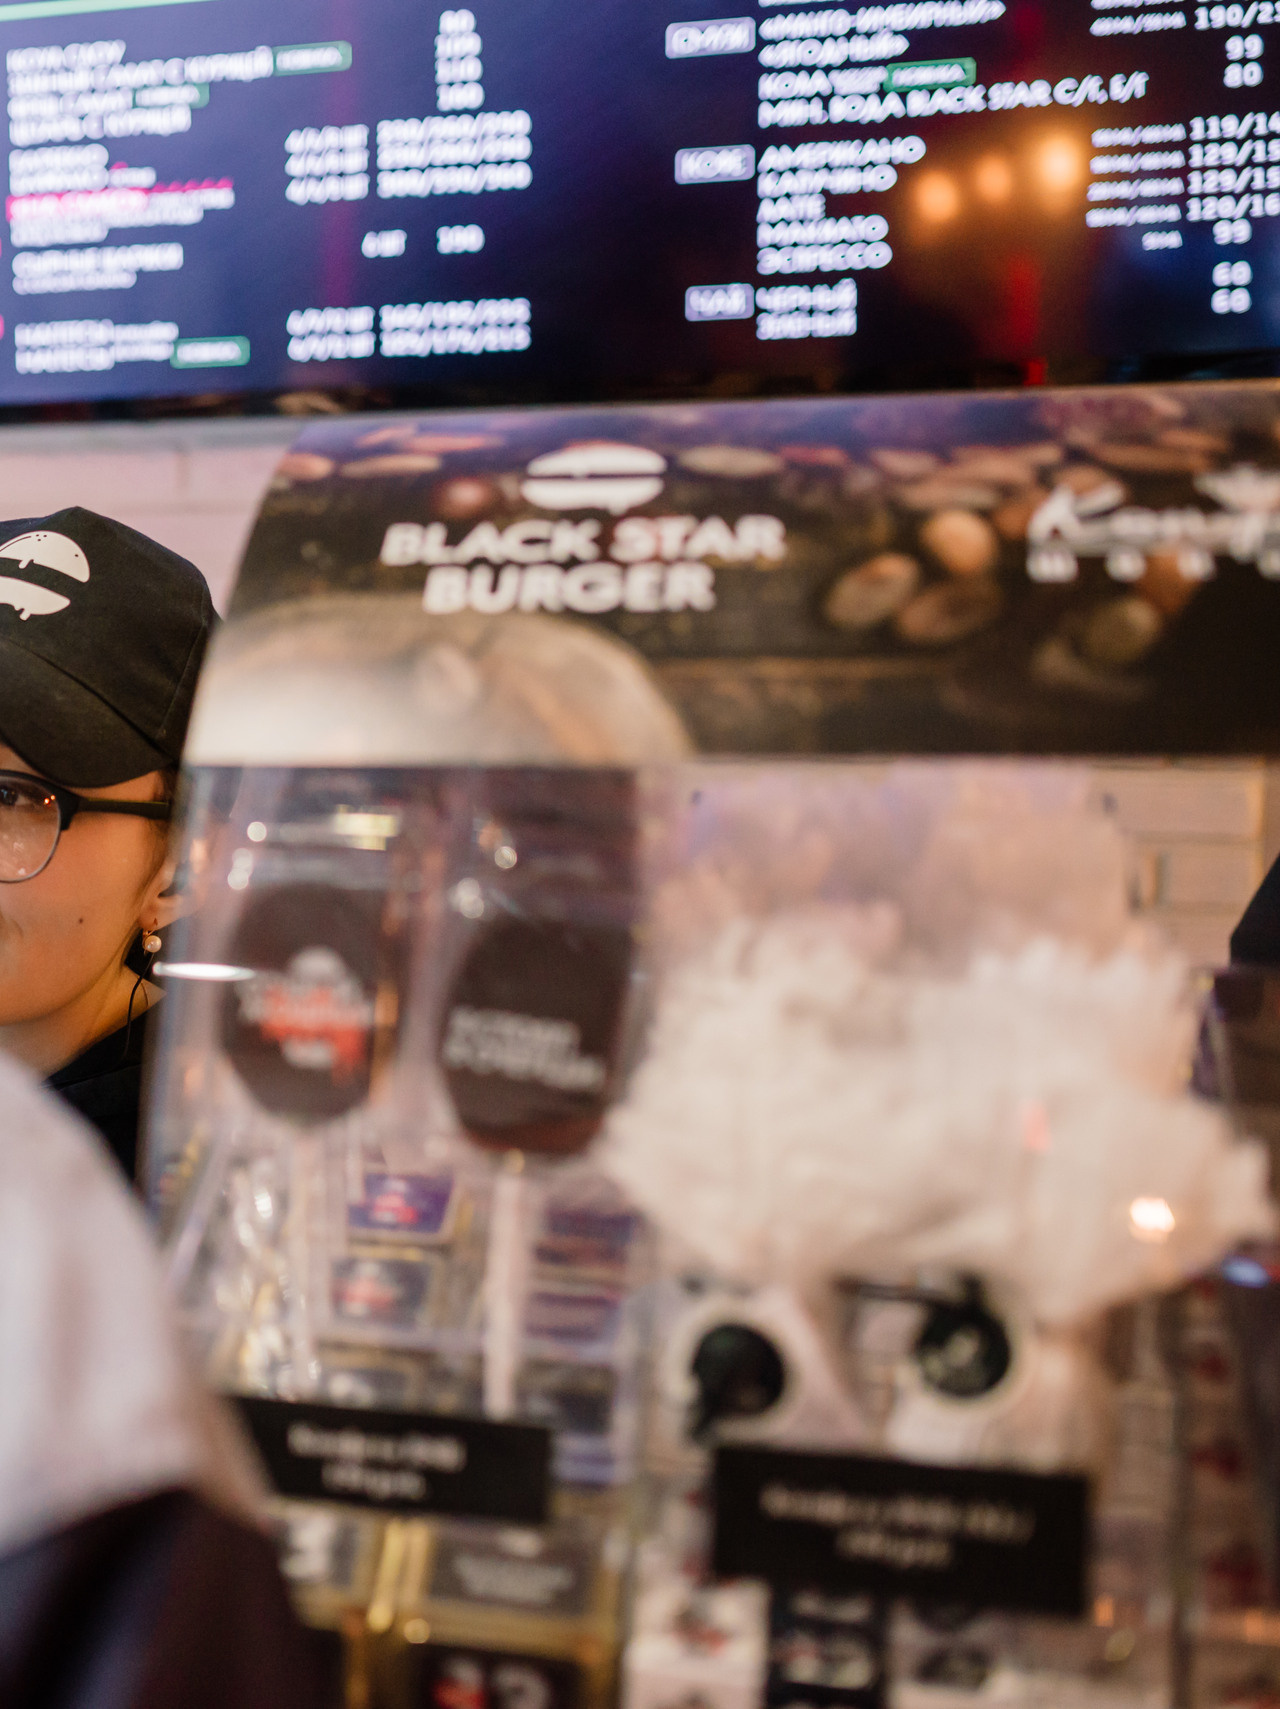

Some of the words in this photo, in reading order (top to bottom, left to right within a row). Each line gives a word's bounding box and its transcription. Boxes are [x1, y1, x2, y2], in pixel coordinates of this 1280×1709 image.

[1225, 33, 1264, 61] 99
[380, 518, 600, 566] BLACK
[609, 514, 788, 562] STAR
[422, 561, 718, 614] BURGER
